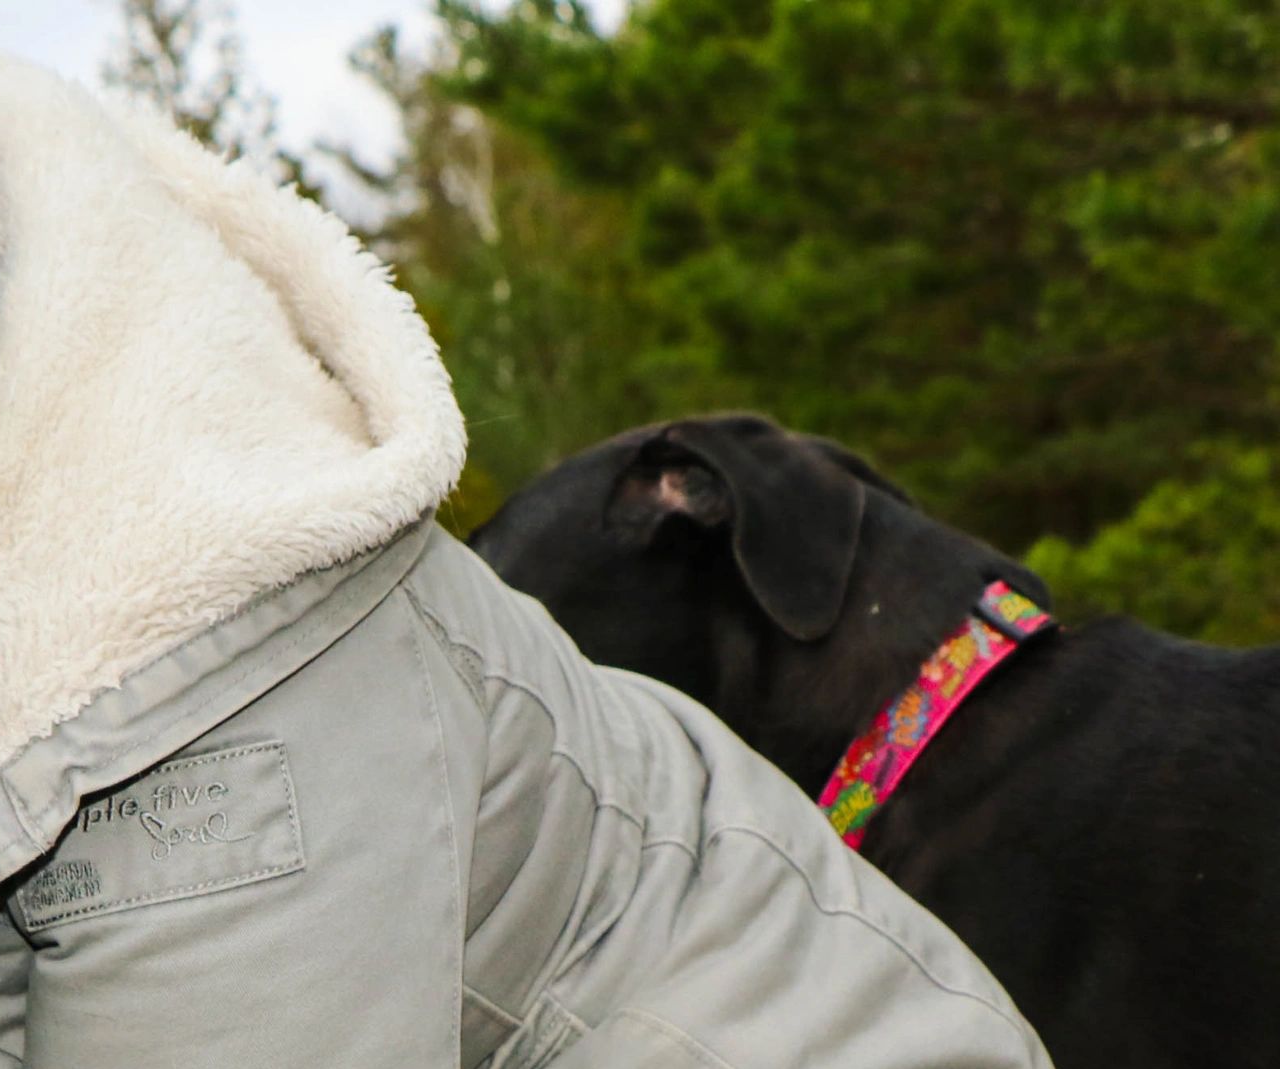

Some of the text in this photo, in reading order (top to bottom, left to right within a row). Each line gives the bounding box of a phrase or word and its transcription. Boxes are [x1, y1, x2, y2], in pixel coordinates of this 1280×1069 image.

[78, 782, 229, 833] ple five
[139, 811, 257, 862] Soul
